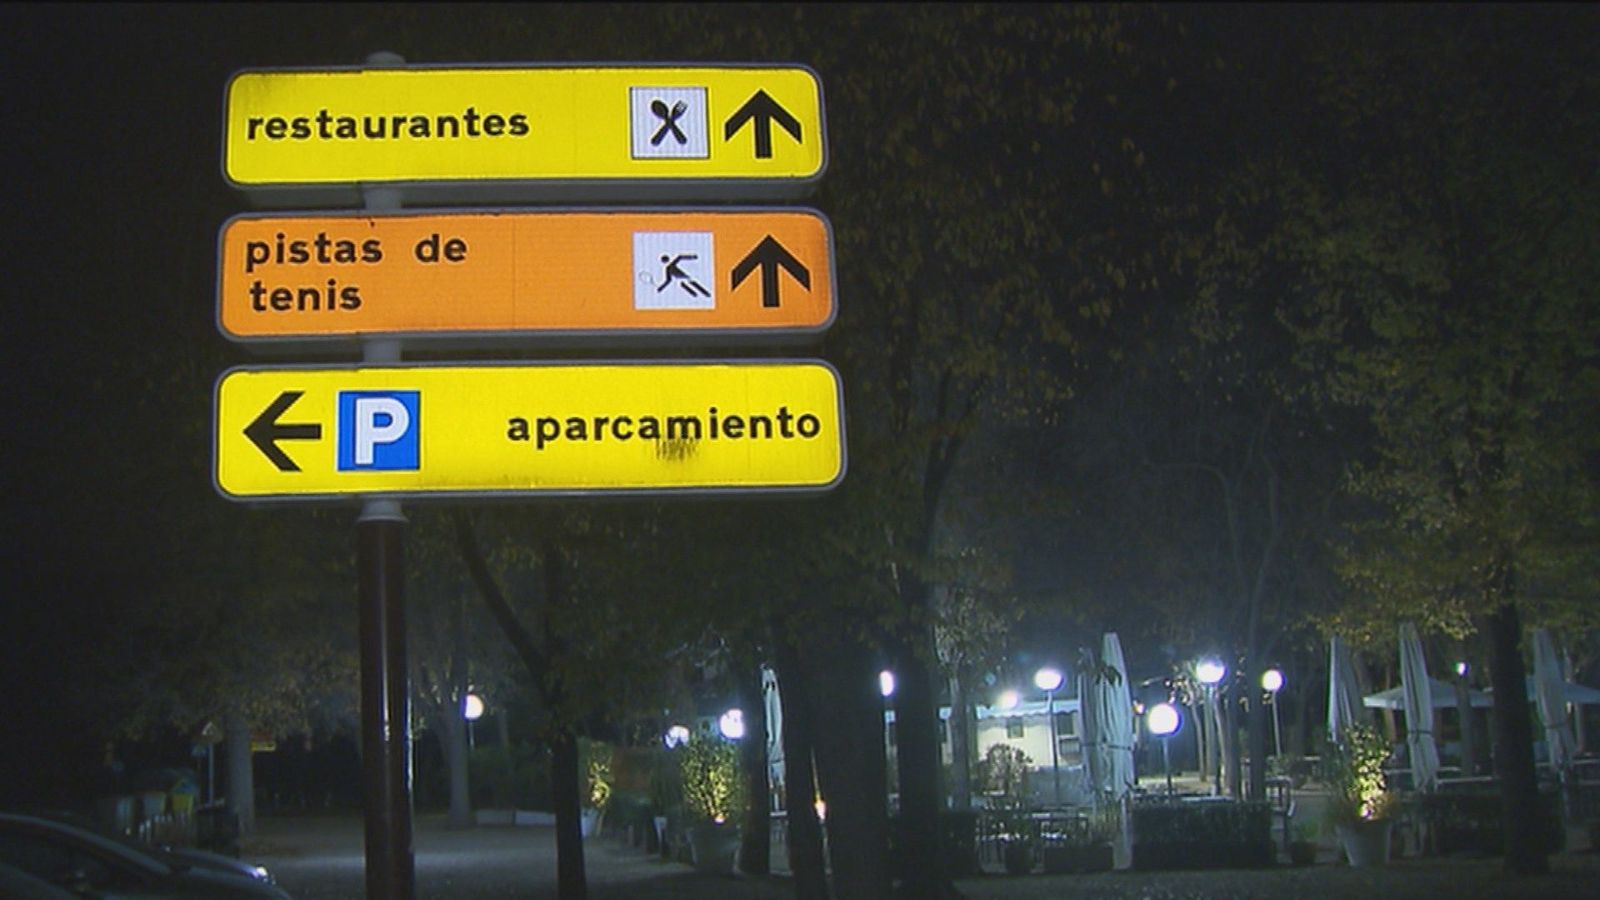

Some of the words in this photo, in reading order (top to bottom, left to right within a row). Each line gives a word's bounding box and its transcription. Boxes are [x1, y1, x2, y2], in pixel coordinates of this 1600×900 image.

[247, 107, 530, 140] restaurantes
[245, 232, 383, 273] pistas
[414, 233, 467, 263] de
[249, 278, 362, 312] tenis
[354, 397, 409, 465] P
[507, 406, 821, 450] aparcamiento
